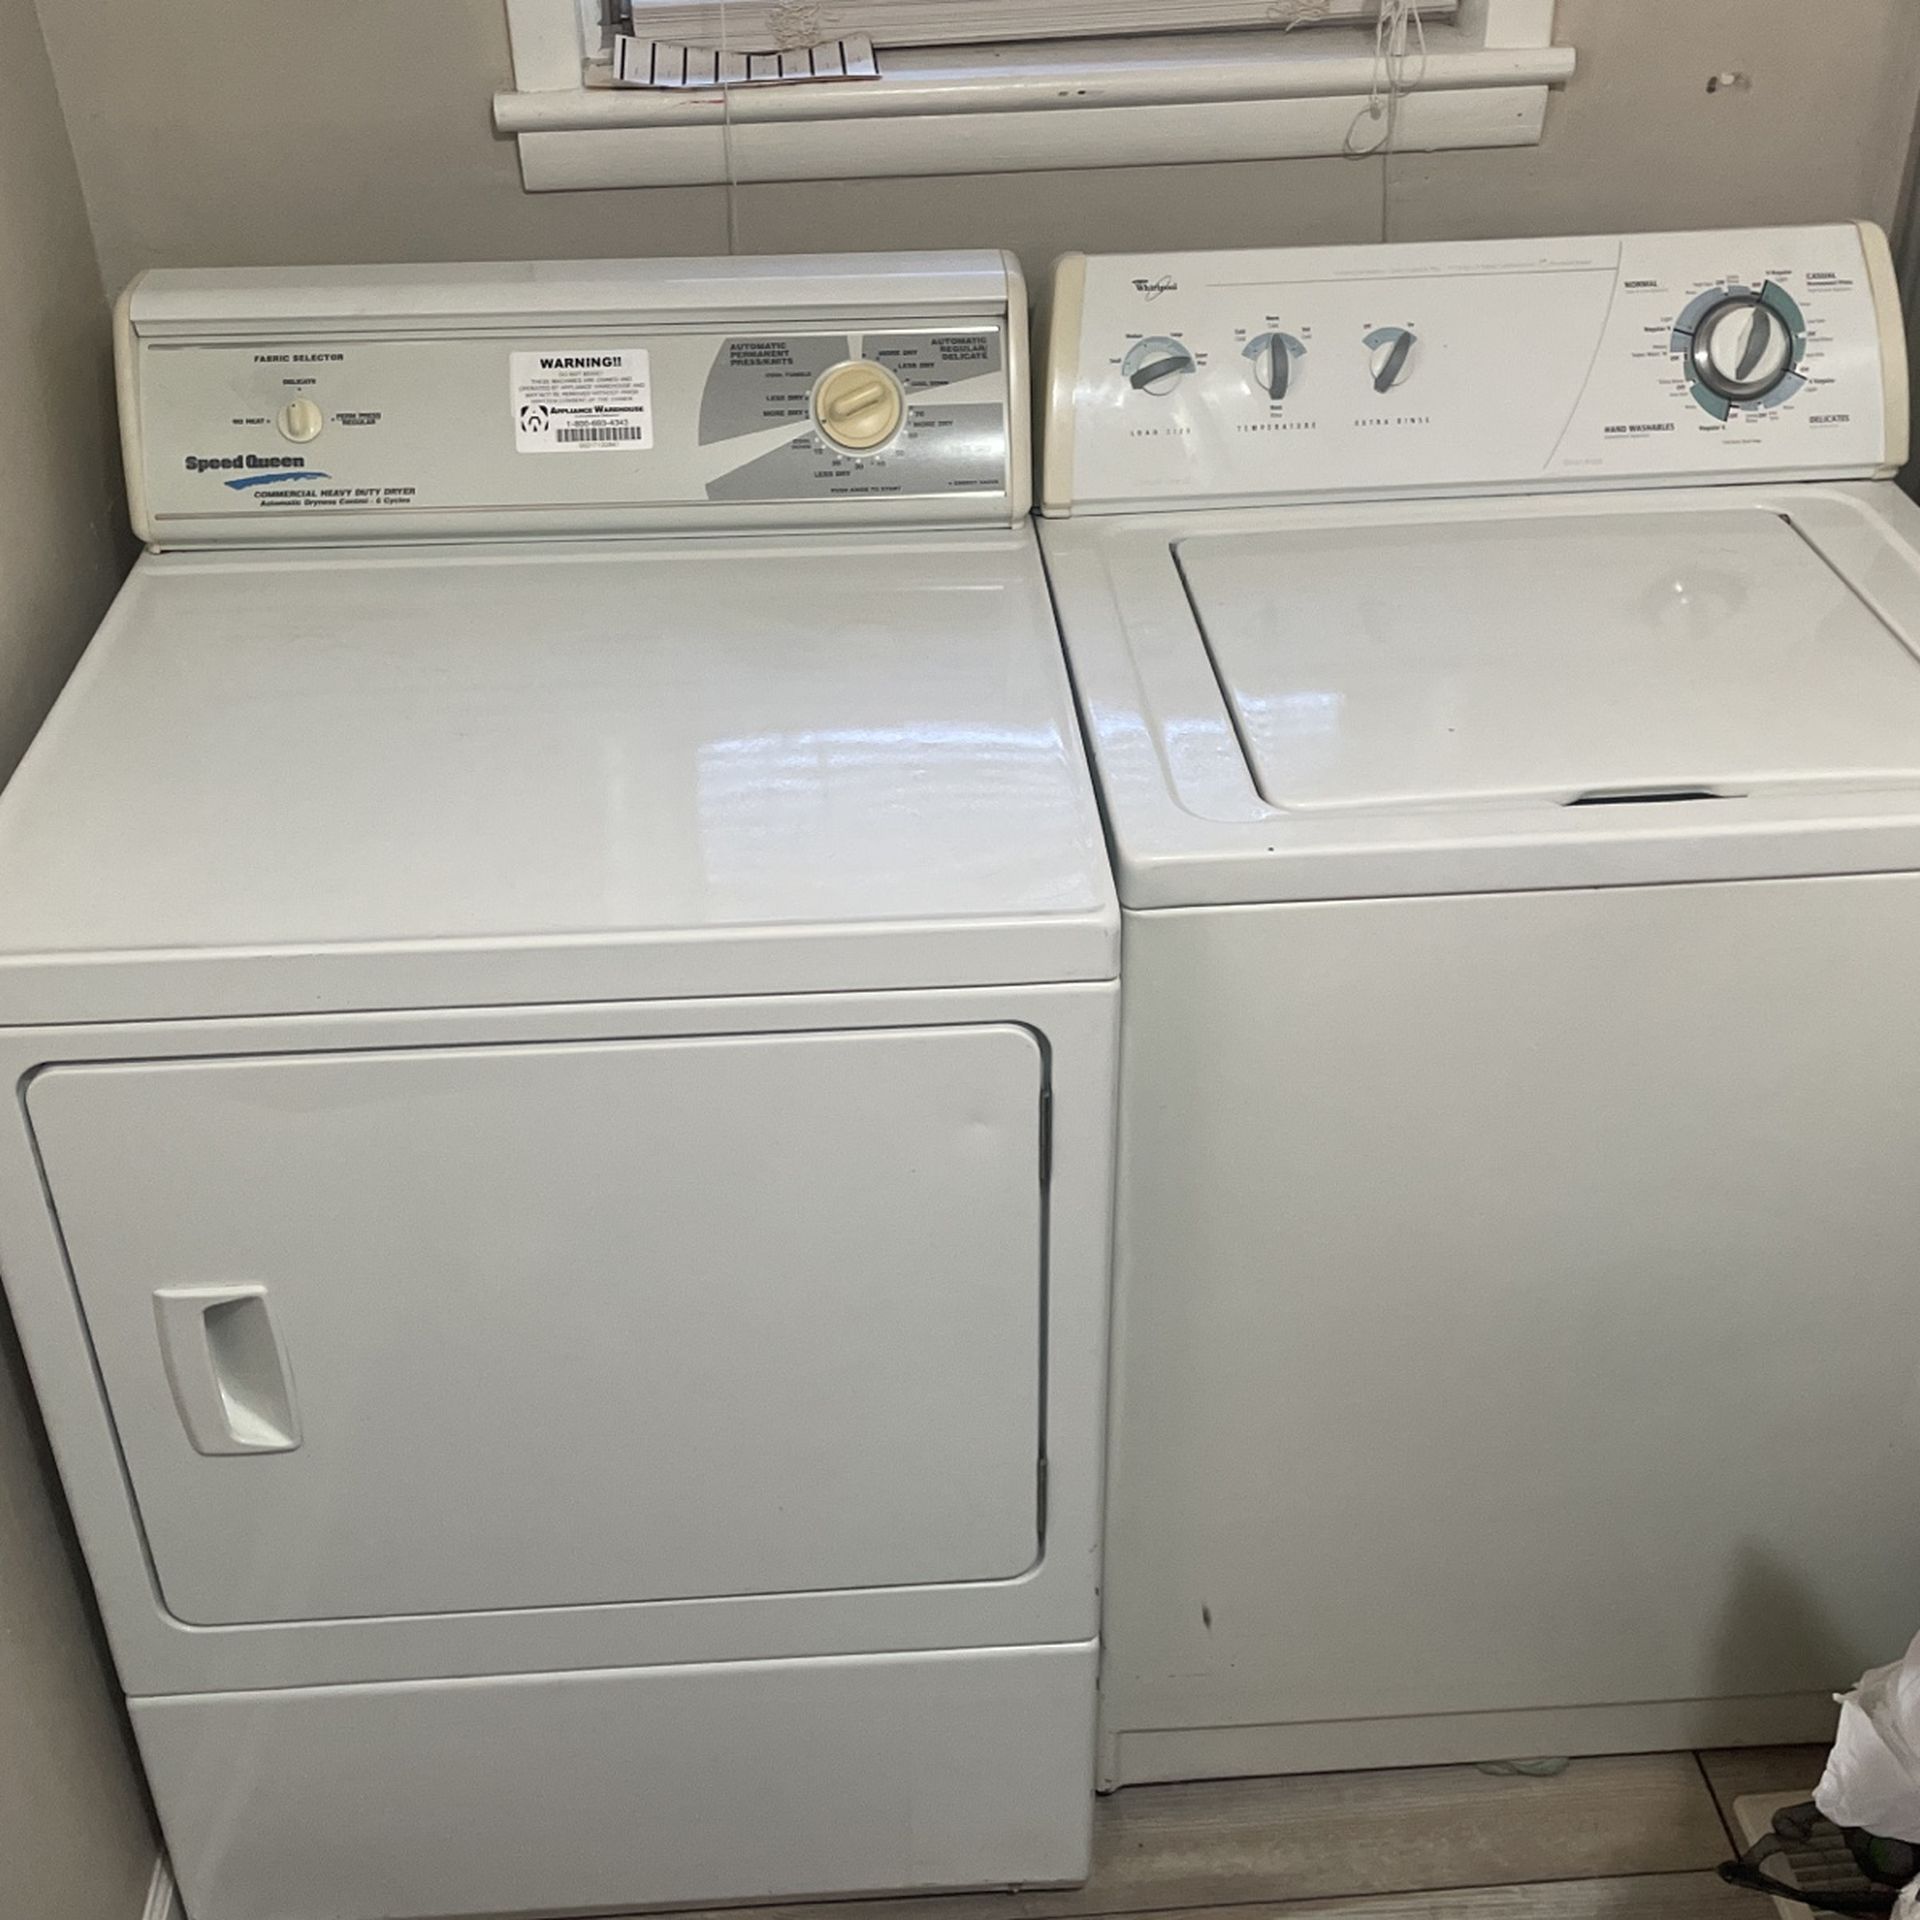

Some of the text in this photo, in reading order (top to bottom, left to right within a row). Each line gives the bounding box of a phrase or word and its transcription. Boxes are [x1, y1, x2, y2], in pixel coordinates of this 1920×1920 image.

[1132, 278, 1178, 293] Whirlpool
[1624, 281, 1658, 289] NORMAL
[730, 342, 787, 350] AUTOMATIC
[931, 337, 987, 346] AUTOMATIC
[293, 353, 344, 362] SELECTOR
[730, 350, 790, 358] PERMANENT
[942, 352, 988, 360] DELICATE
[540, 356, 622, 369] WARNING!!
[1809, 414, 1850, 424] DELICATES
[1237, 422, 1317, 432] TEMPERATURE
[1604, 423, 1675, 433] HAND WASHABLES
[185, 455, 305, 472] Speed Queen
[254, 487, 416, 498] COMMERCIAL HEAVY DUTY DRYER
